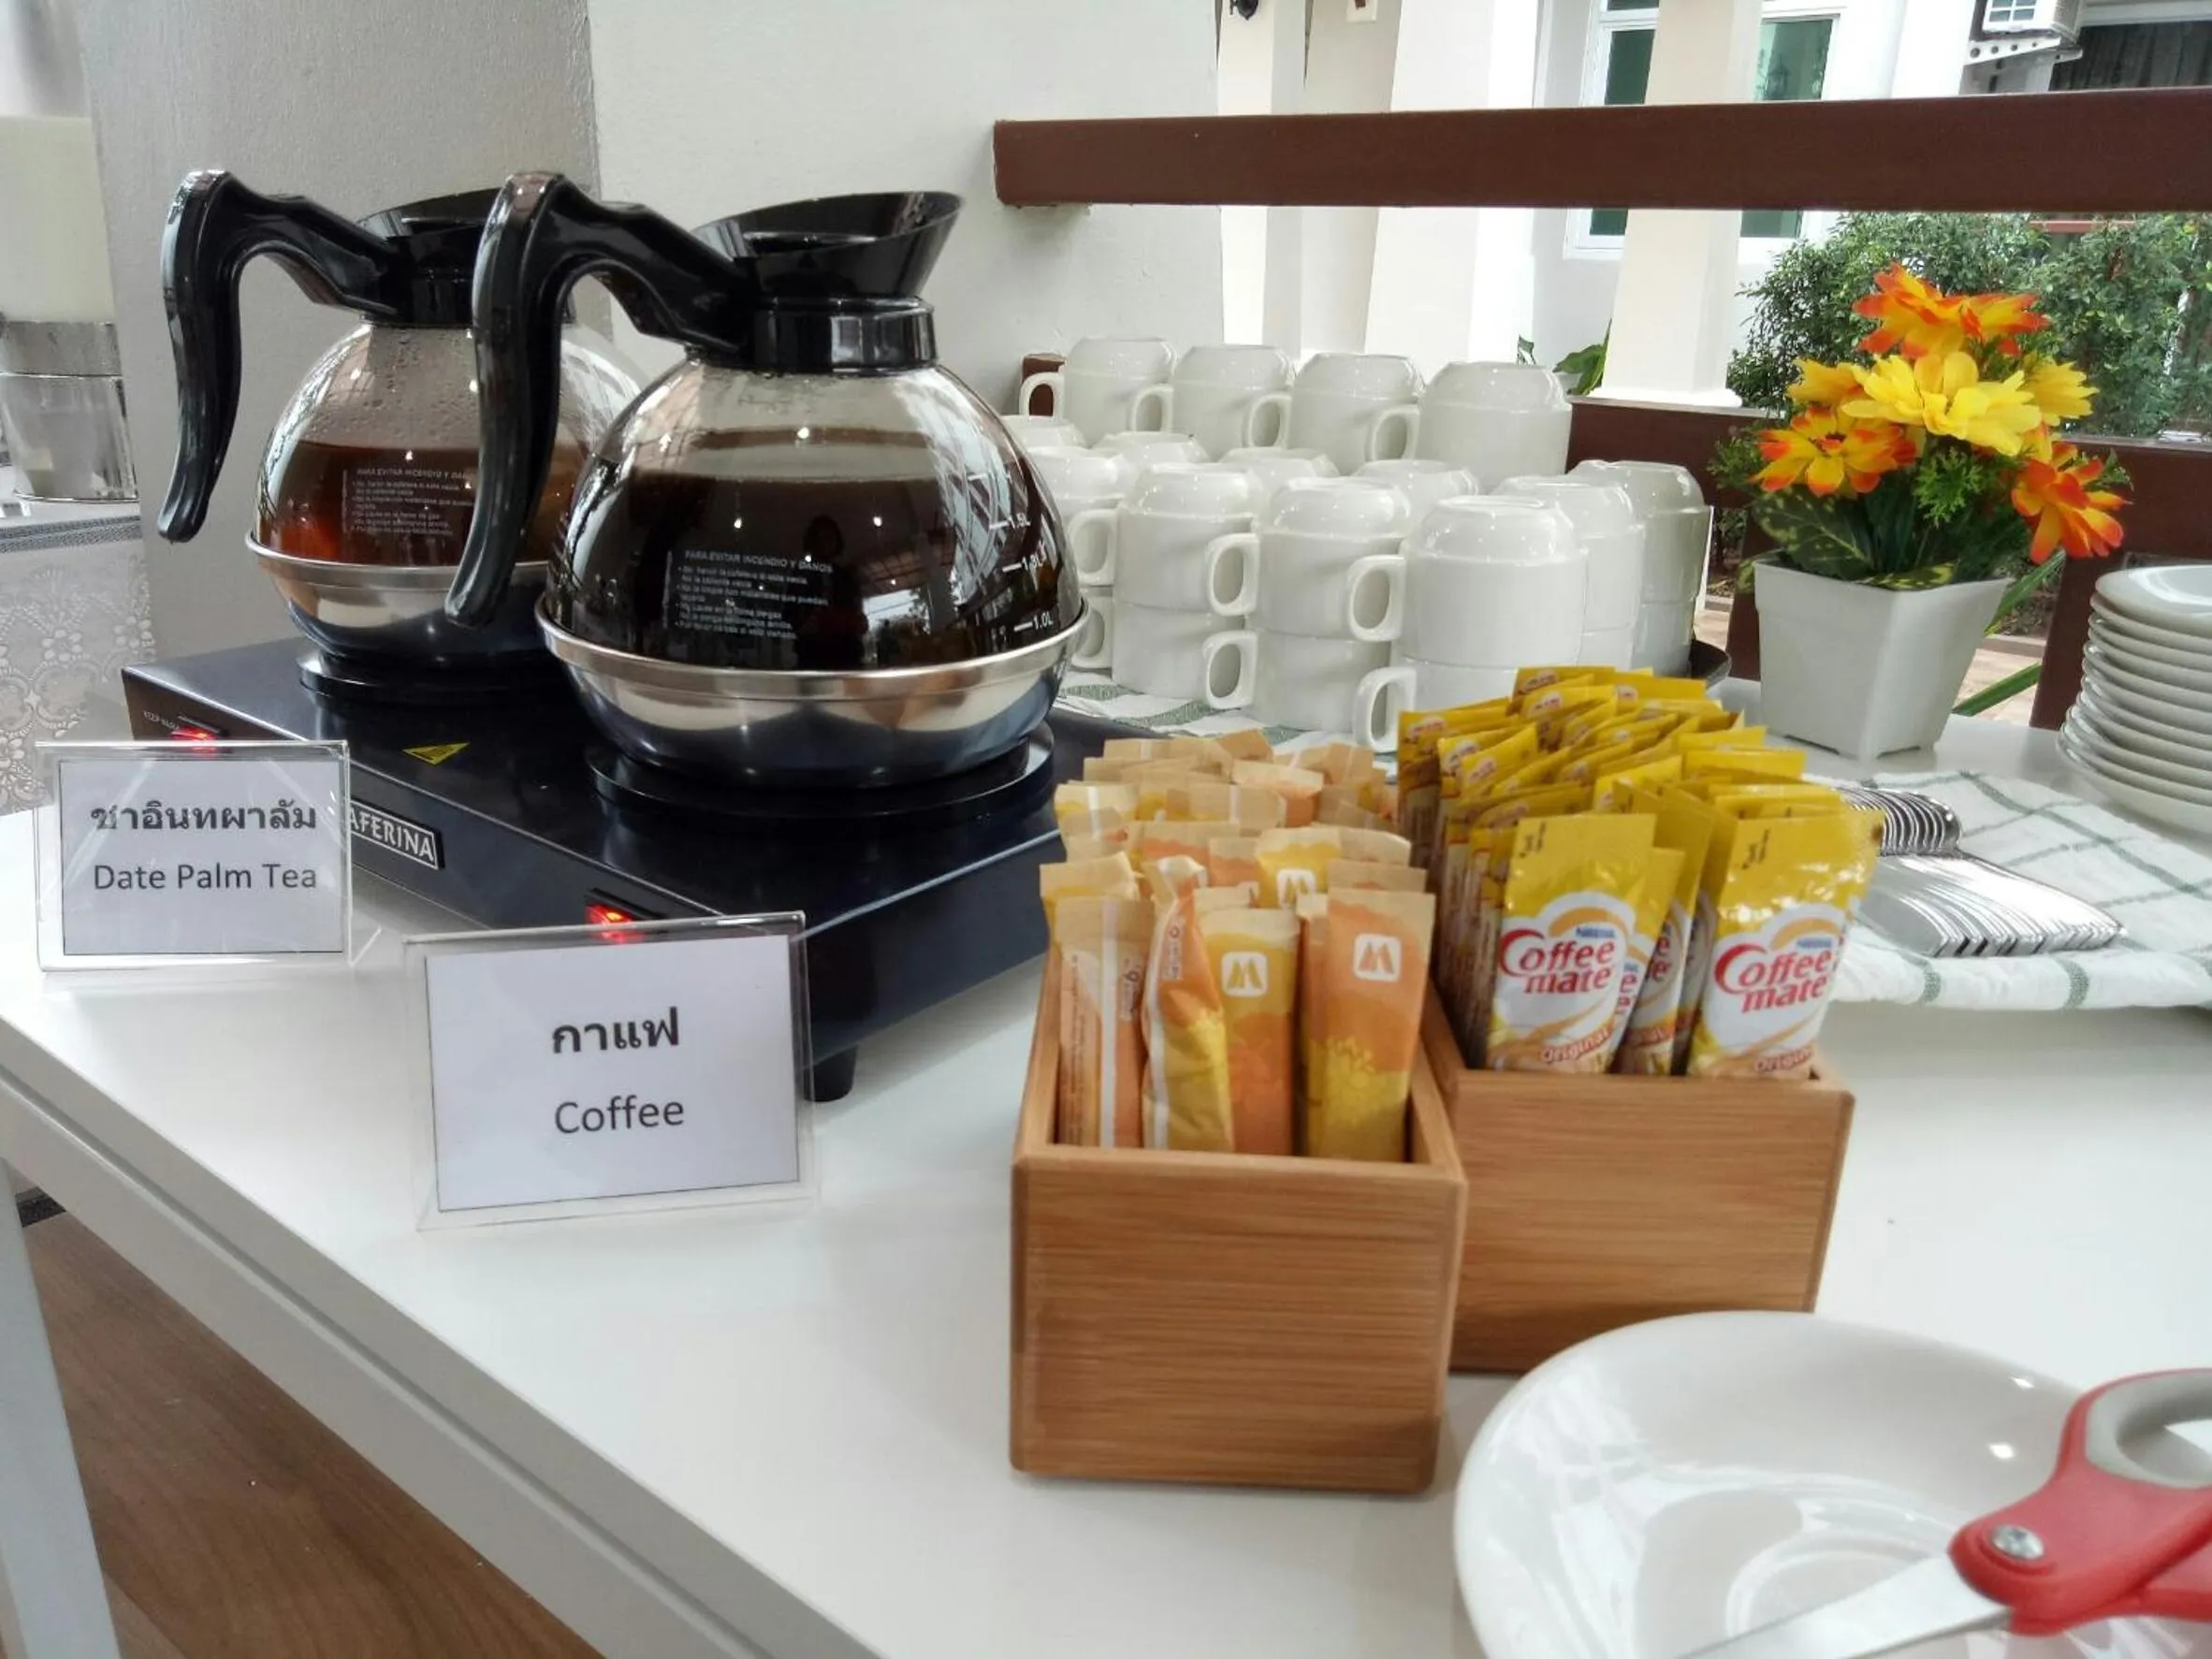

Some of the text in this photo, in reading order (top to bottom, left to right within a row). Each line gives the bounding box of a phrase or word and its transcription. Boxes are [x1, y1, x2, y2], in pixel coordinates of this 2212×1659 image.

[1032, 612, 1054, 630] 1.0L
[91, 799, 316, 831] ชาอินทผาลัม
[350, 806, 434, 862] AFERINA
[95, 863, 316, 890] Date Palm Tea
[1498, 928, 1616, 977] Coffee
[1714, 942, 1832, 995] Coffee
[1523, 964, 1612, 995] mate
[1741, 976, 1828, 1013] mate
[552, 1006, 679, 1054] กาแฟ
[555, 1094, 684, 1134] Coffee
